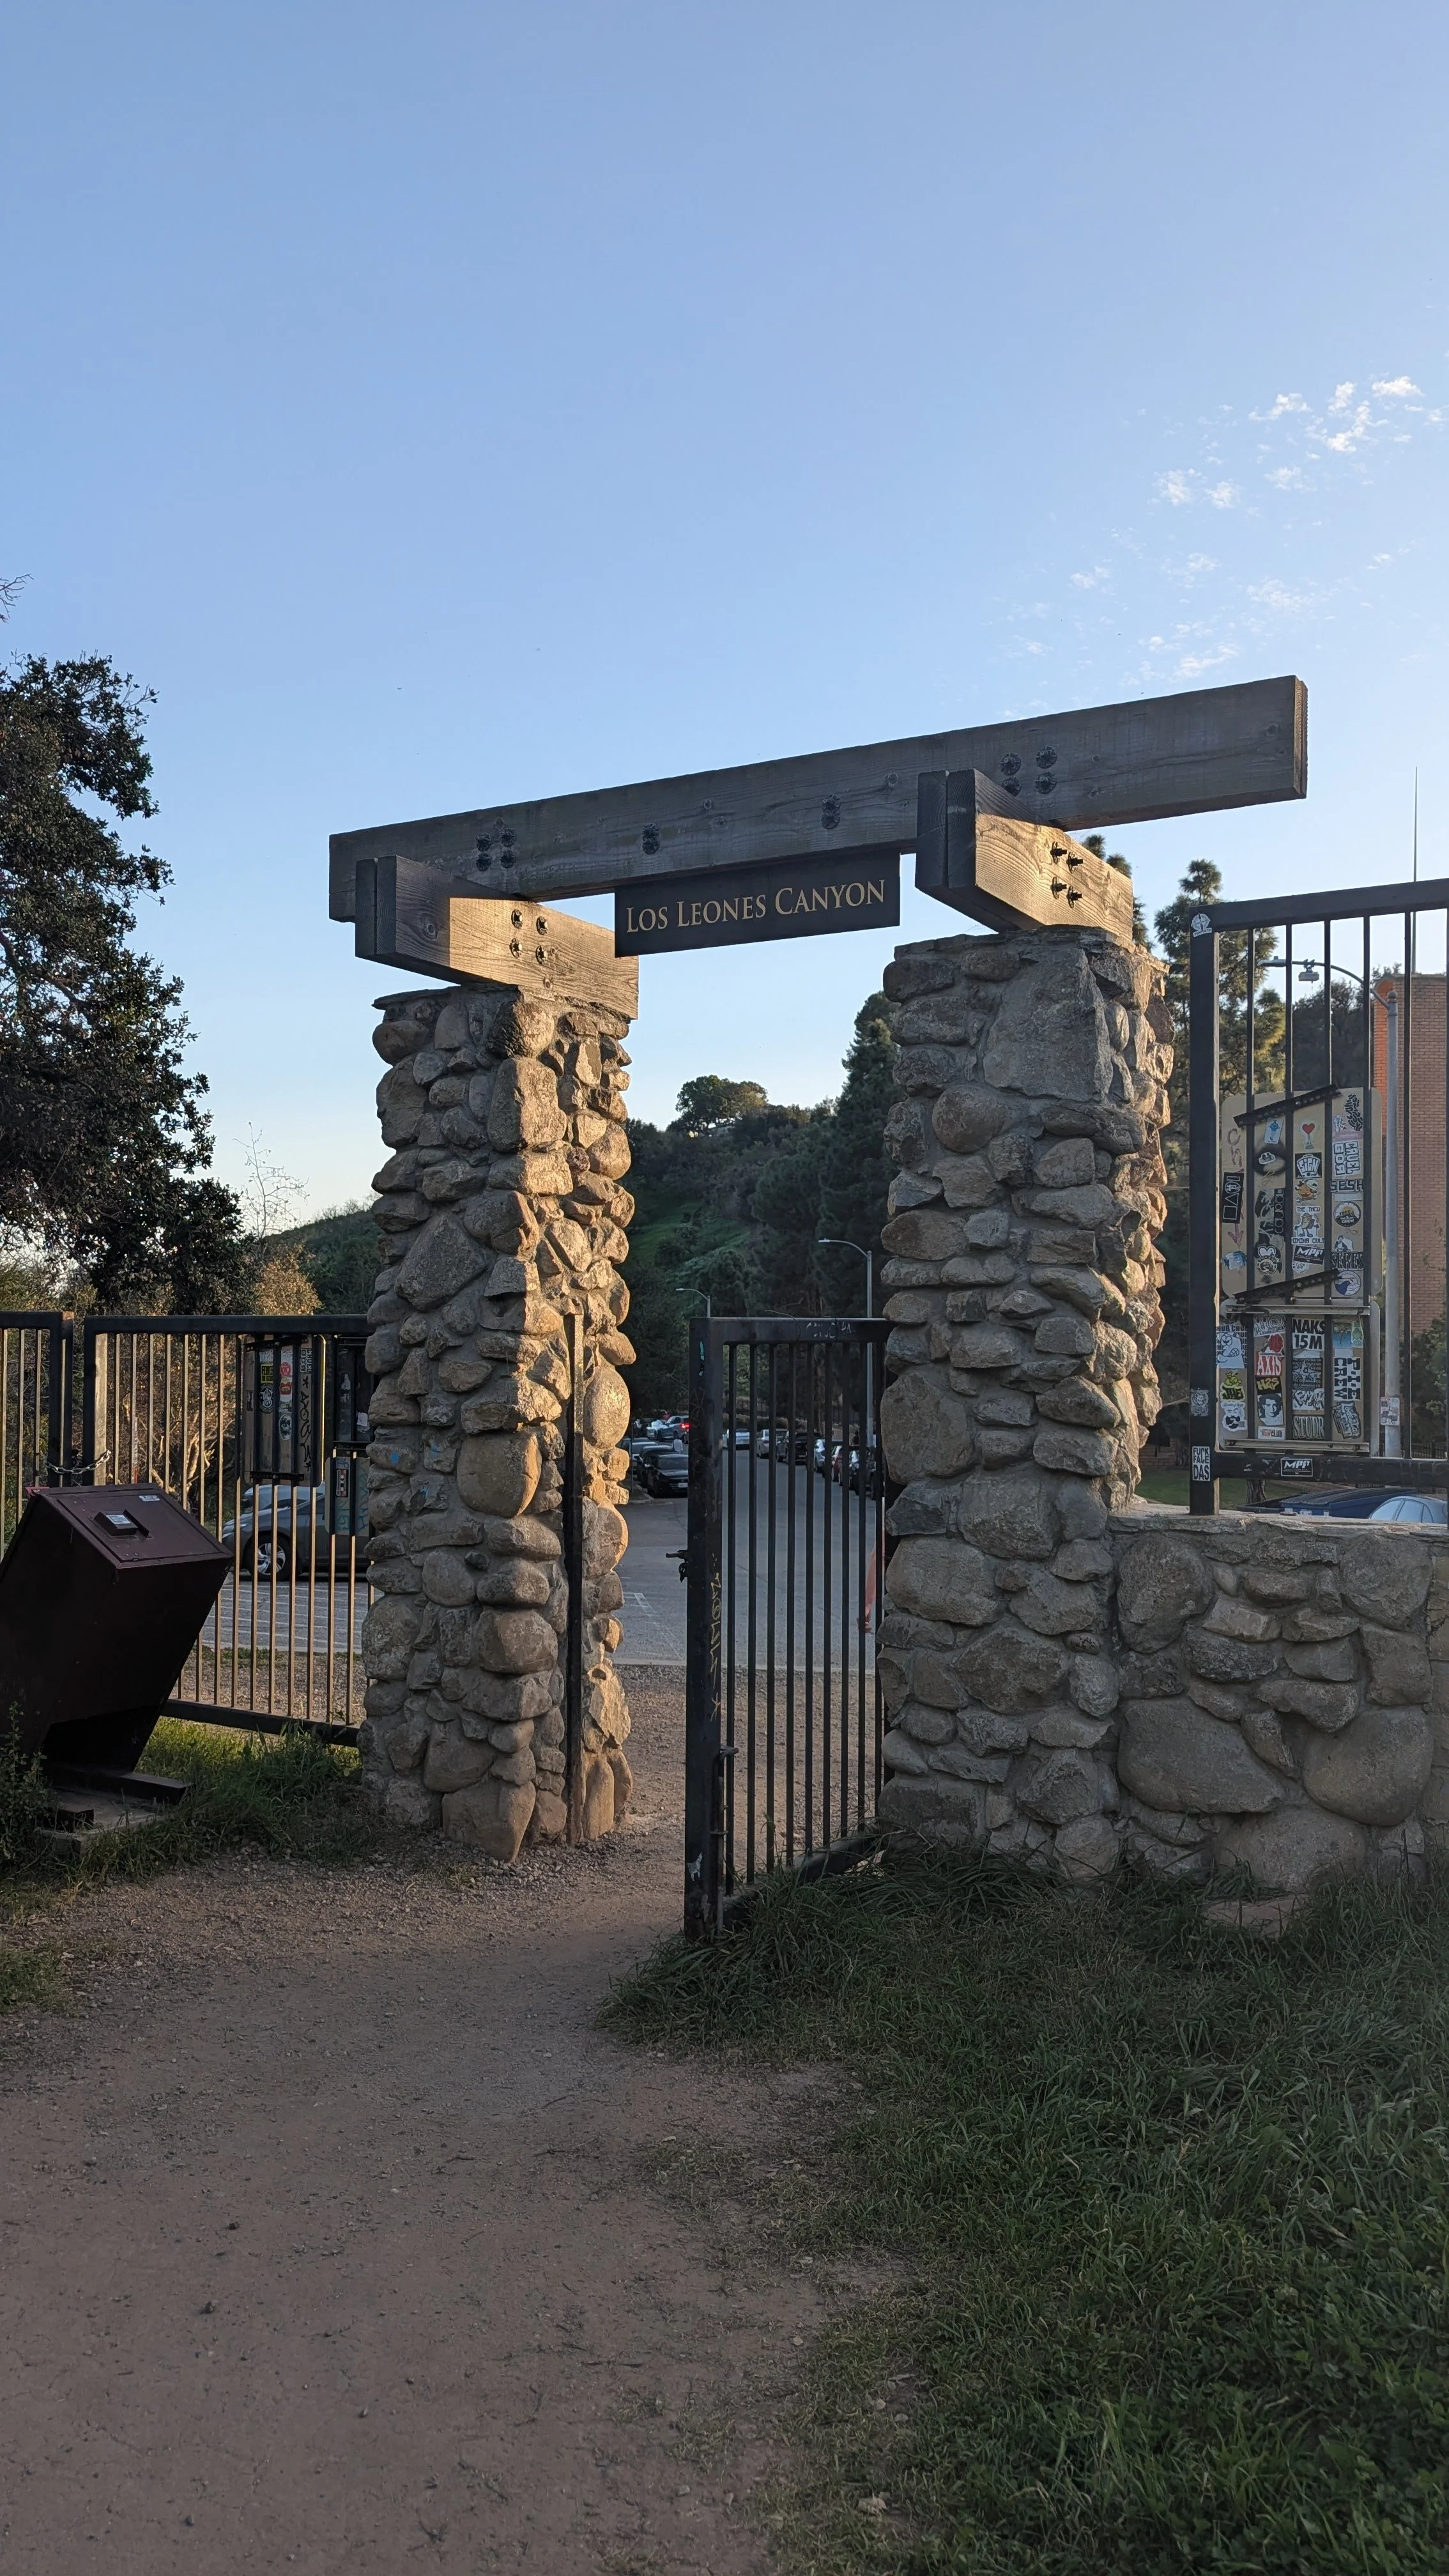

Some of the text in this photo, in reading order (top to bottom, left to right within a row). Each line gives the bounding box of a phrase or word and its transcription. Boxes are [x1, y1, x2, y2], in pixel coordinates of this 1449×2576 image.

[627, 879, 887, 933] LOS LEONES CANYON
[1292, 1319, 1324, 1334] NAKS
[1256, 1354, 1282, 1376] AXIS
[1334, 1357, 1347, 1400] CREW
[1193, 1447, 1209, 1456] FUCK
[1193, 1464, 1209, 1480] DAS
